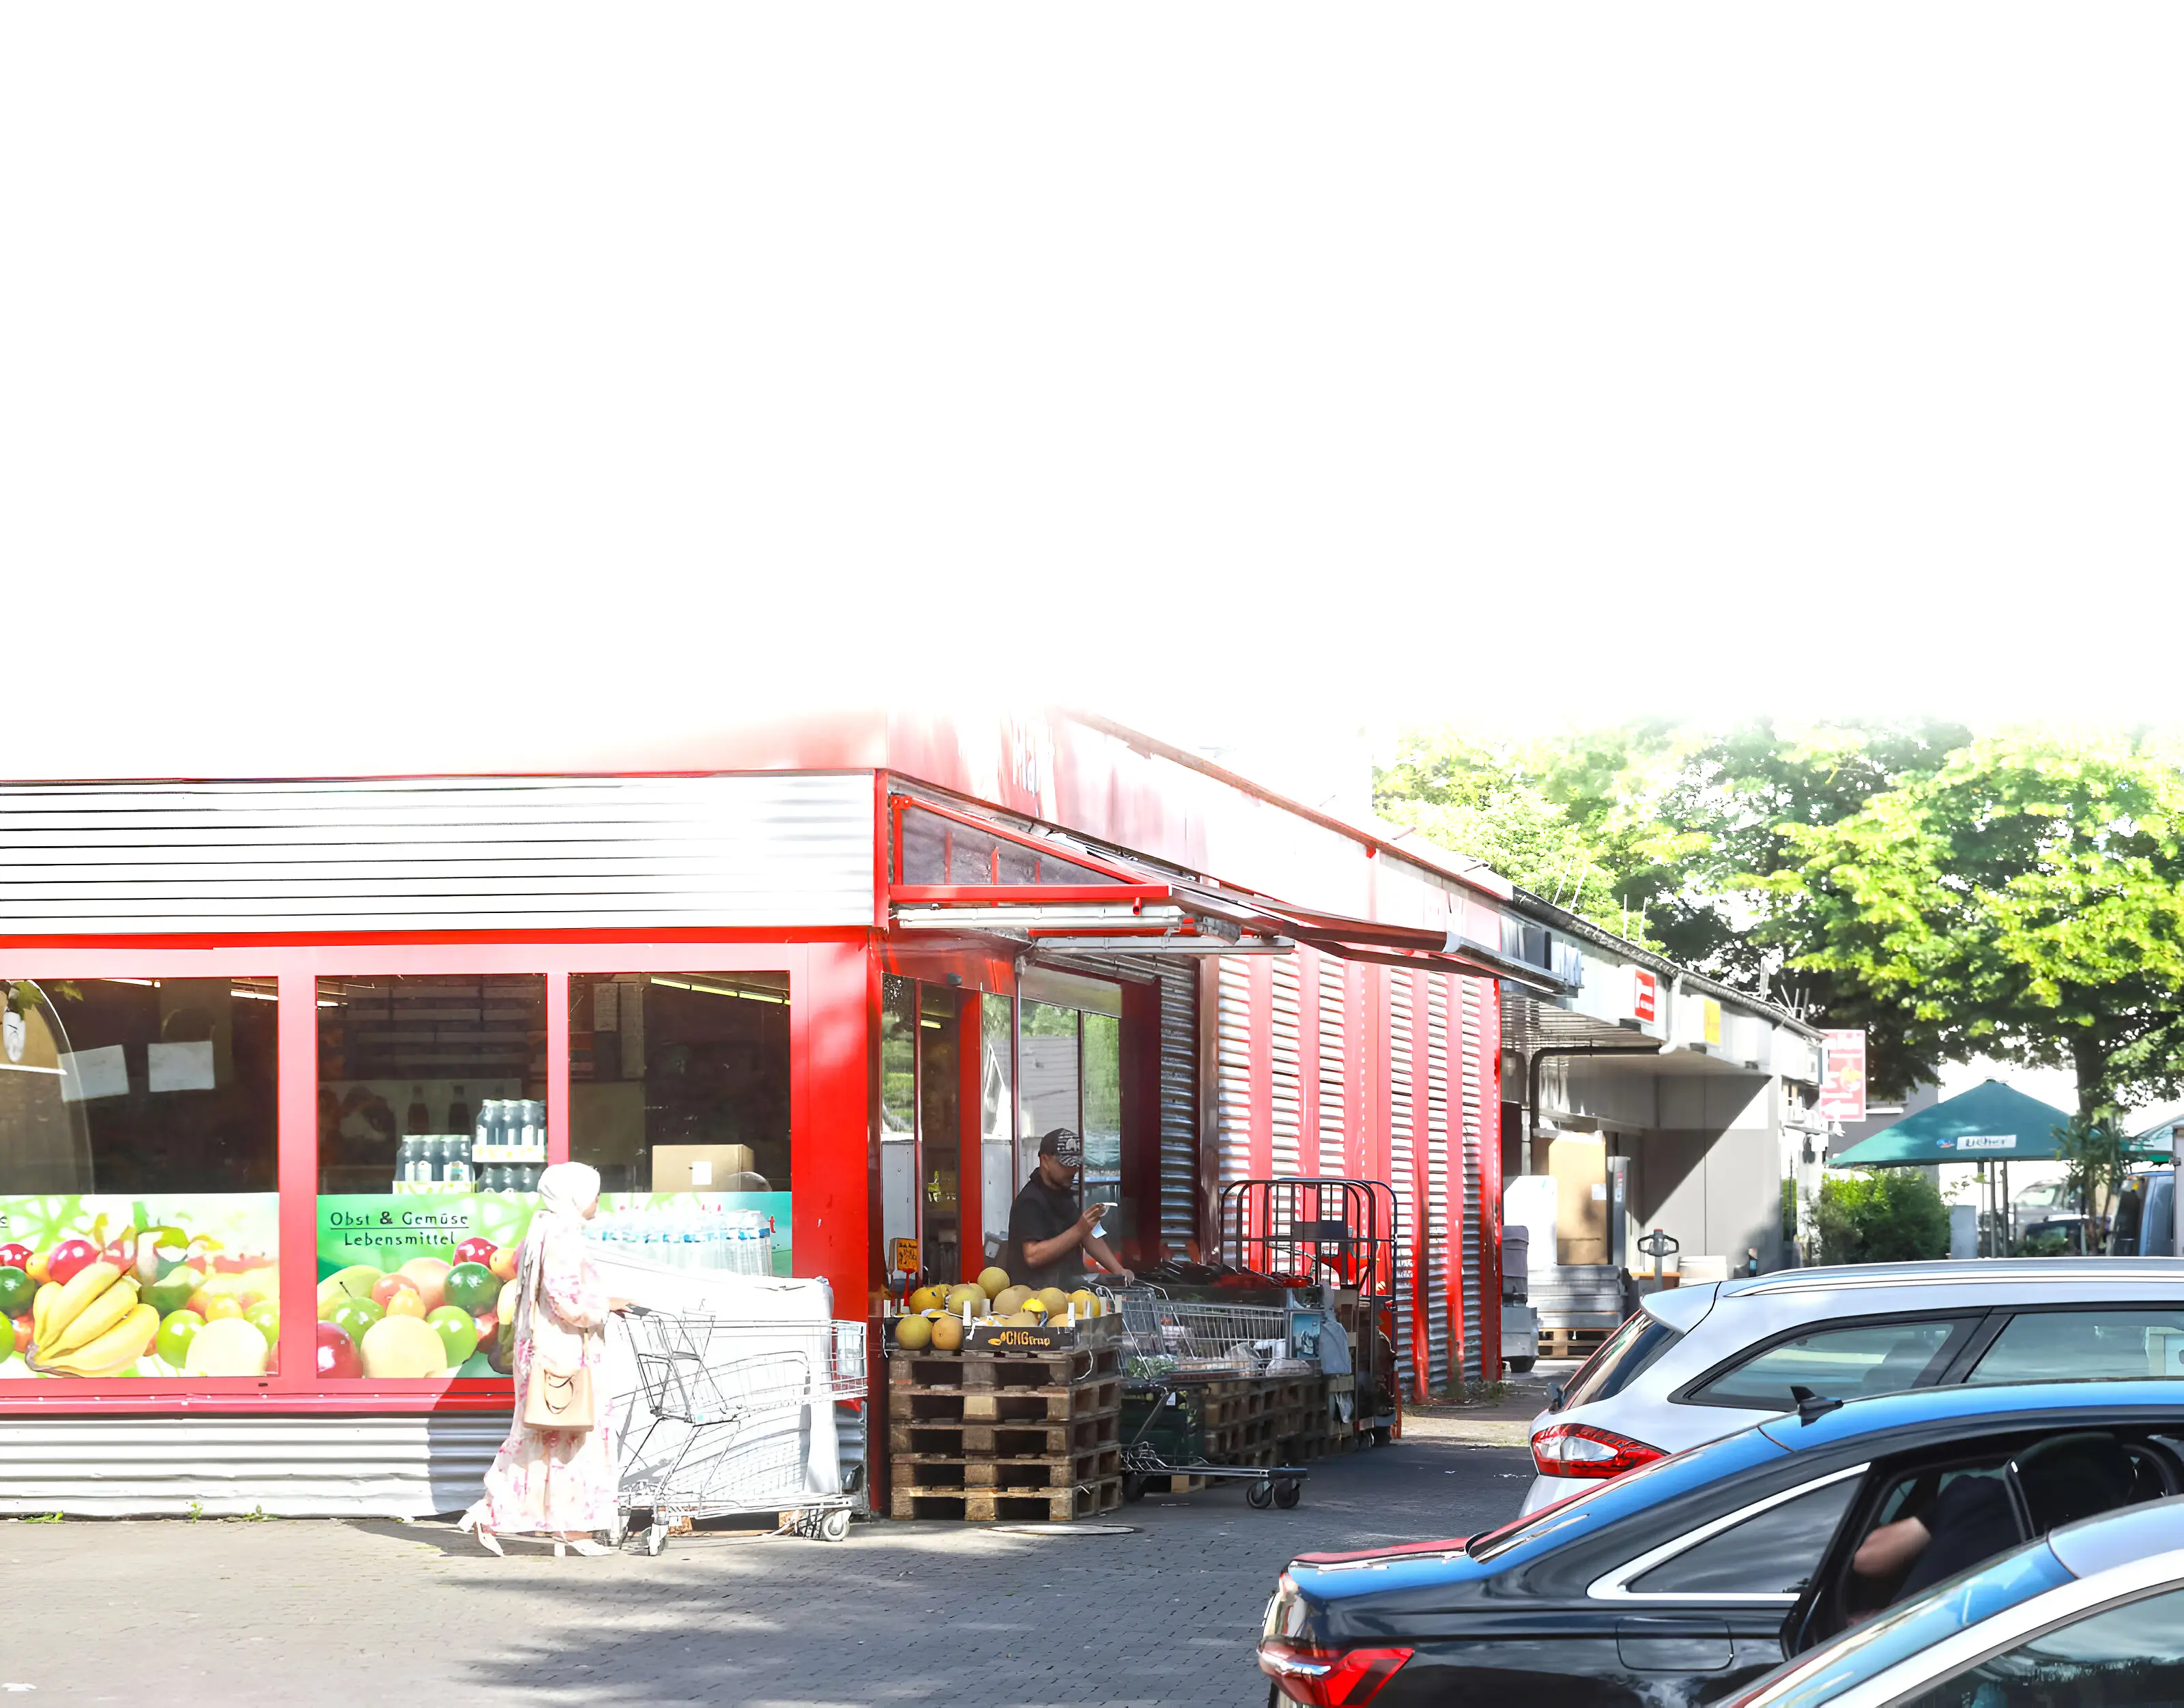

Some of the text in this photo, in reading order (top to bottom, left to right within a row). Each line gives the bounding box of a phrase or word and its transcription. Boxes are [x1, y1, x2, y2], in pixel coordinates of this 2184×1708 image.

[330, 1211, 469, 1226] Obst & Gemüse
[345, 1231, 456, 1246] Lebensmittel
